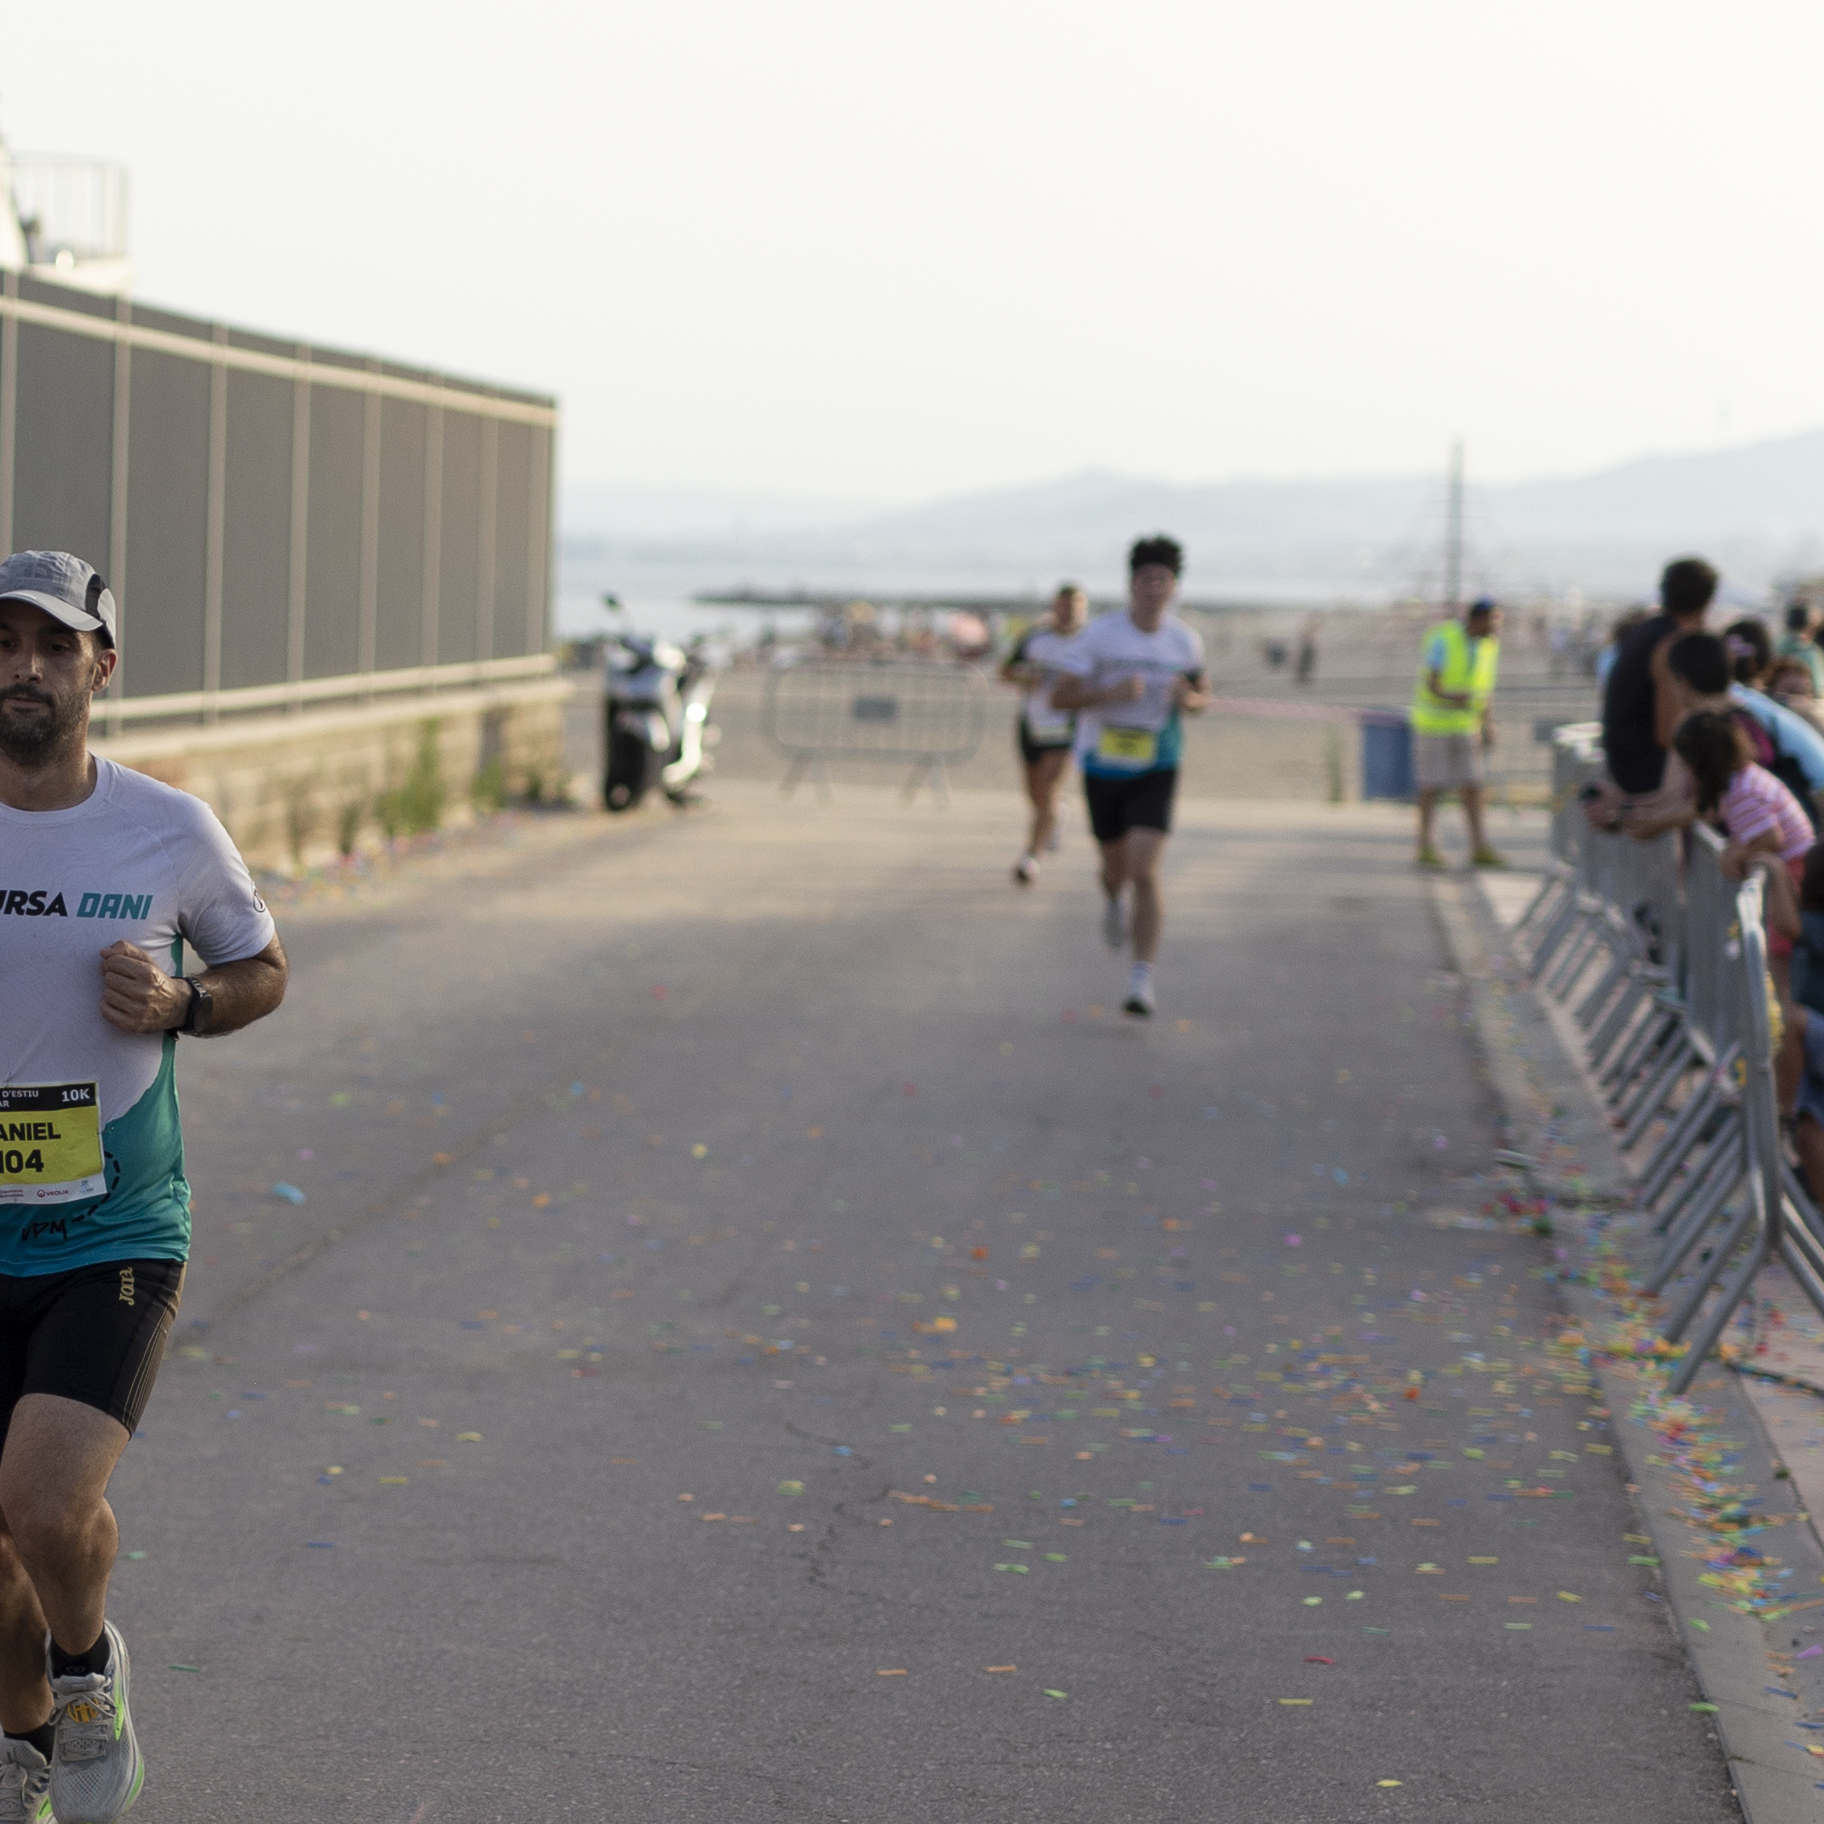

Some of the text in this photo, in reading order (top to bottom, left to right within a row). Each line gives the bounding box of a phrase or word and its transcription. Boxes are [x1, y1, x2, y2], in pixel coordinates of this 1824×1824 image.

[76, 892, 154, 921] DANI
[2, 1089, 39, 1099] D'ESTIU
[61, 1088, 90, 1102] 10K
